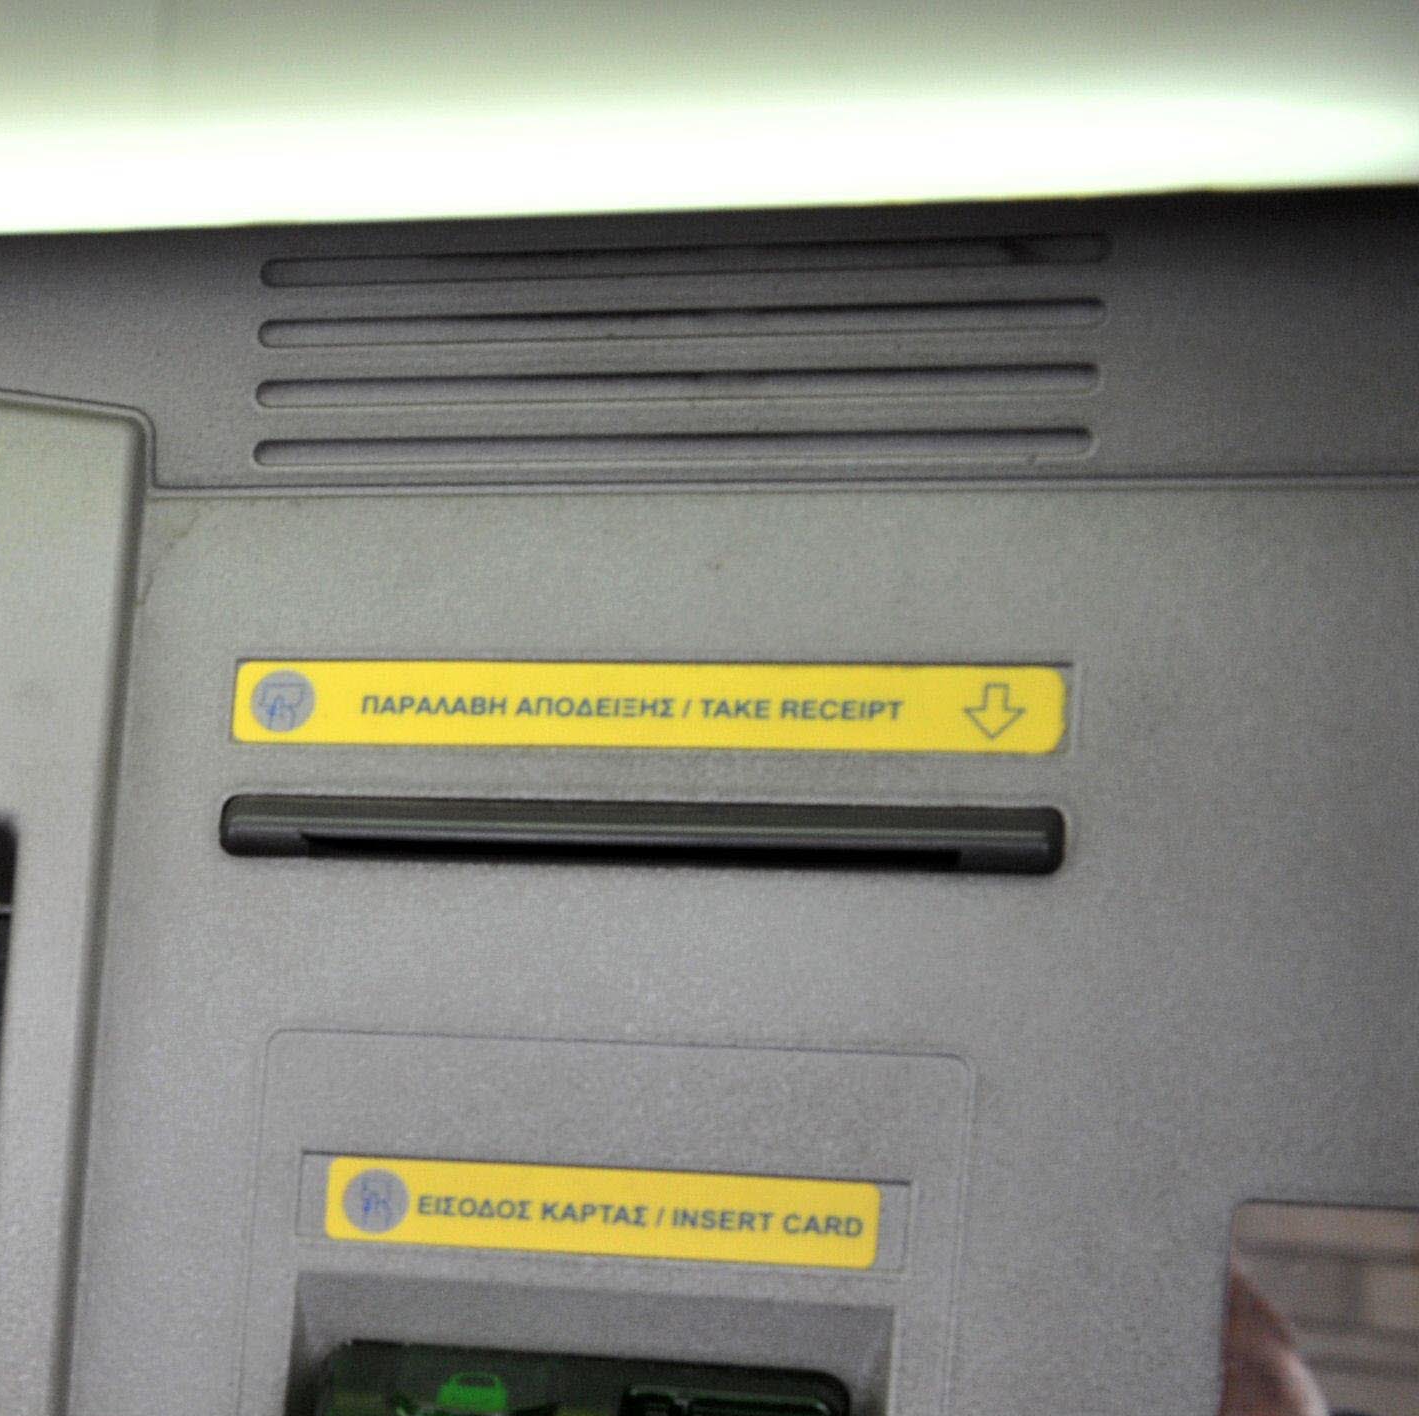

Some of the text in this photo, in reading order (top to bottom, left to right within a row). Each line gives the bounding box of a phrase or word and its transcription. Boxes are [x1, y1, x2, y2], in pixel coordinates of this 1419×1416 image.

[361, 693, 904, 723] ΠΑΡΑΛΑΒΗ ΑΠΟΔΕΙΞΗΣ / TAKE RECEIPT
[417, 1195, 864, 1239] ΕΙΣΟΔΟΣ ΚΑΡΤΑΣ / INSERT CARD
